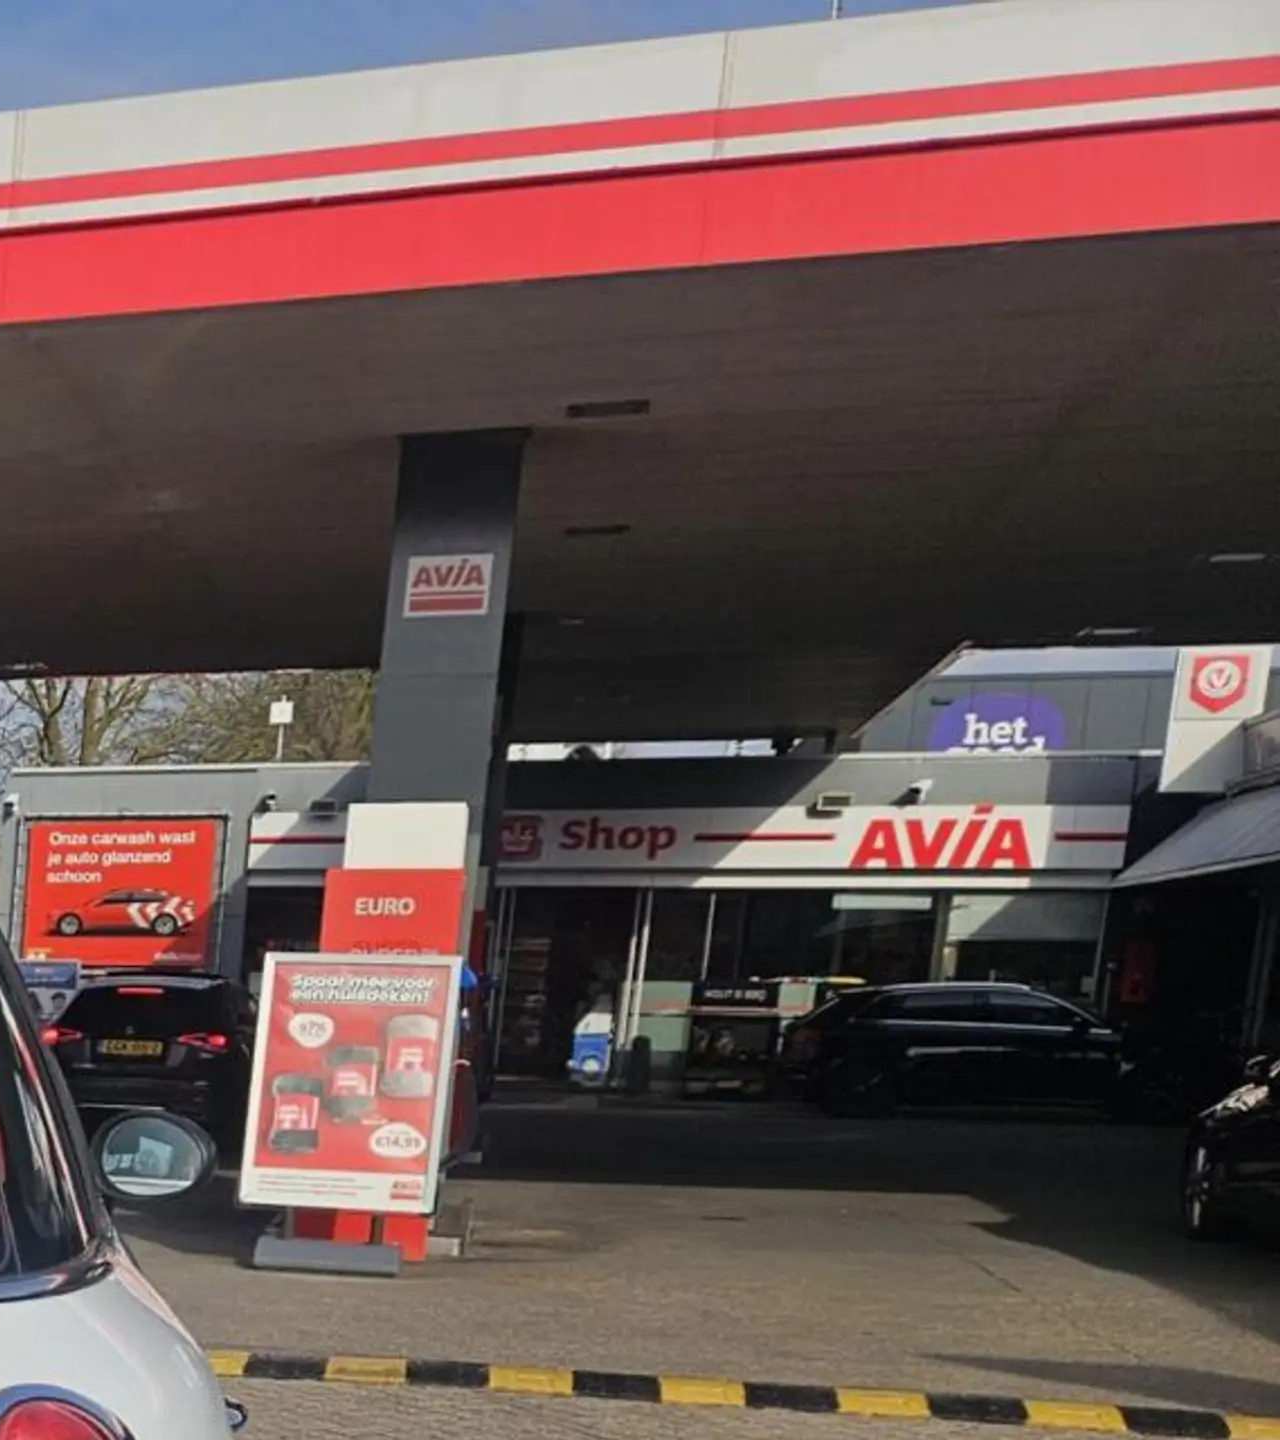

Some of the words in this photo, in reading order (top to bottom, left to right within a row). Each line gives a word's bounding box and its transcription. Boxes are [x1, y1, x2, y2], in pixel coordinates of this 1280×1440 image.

[412, 557, 485, 588] AVIA
[962, 712, 1028, 745] het
[49, 832, 88, 845] Onze
[159, 830, 196, 844] wast
[559, 816, 677, 860] Shop
[849, 802, 1033, 870] AVIA
[46, 850, 62, 867] je
[65, 851, 99, 864] auto
[46, 869, 102, 883] schoon
[354, 897, 416, 916] EURO
